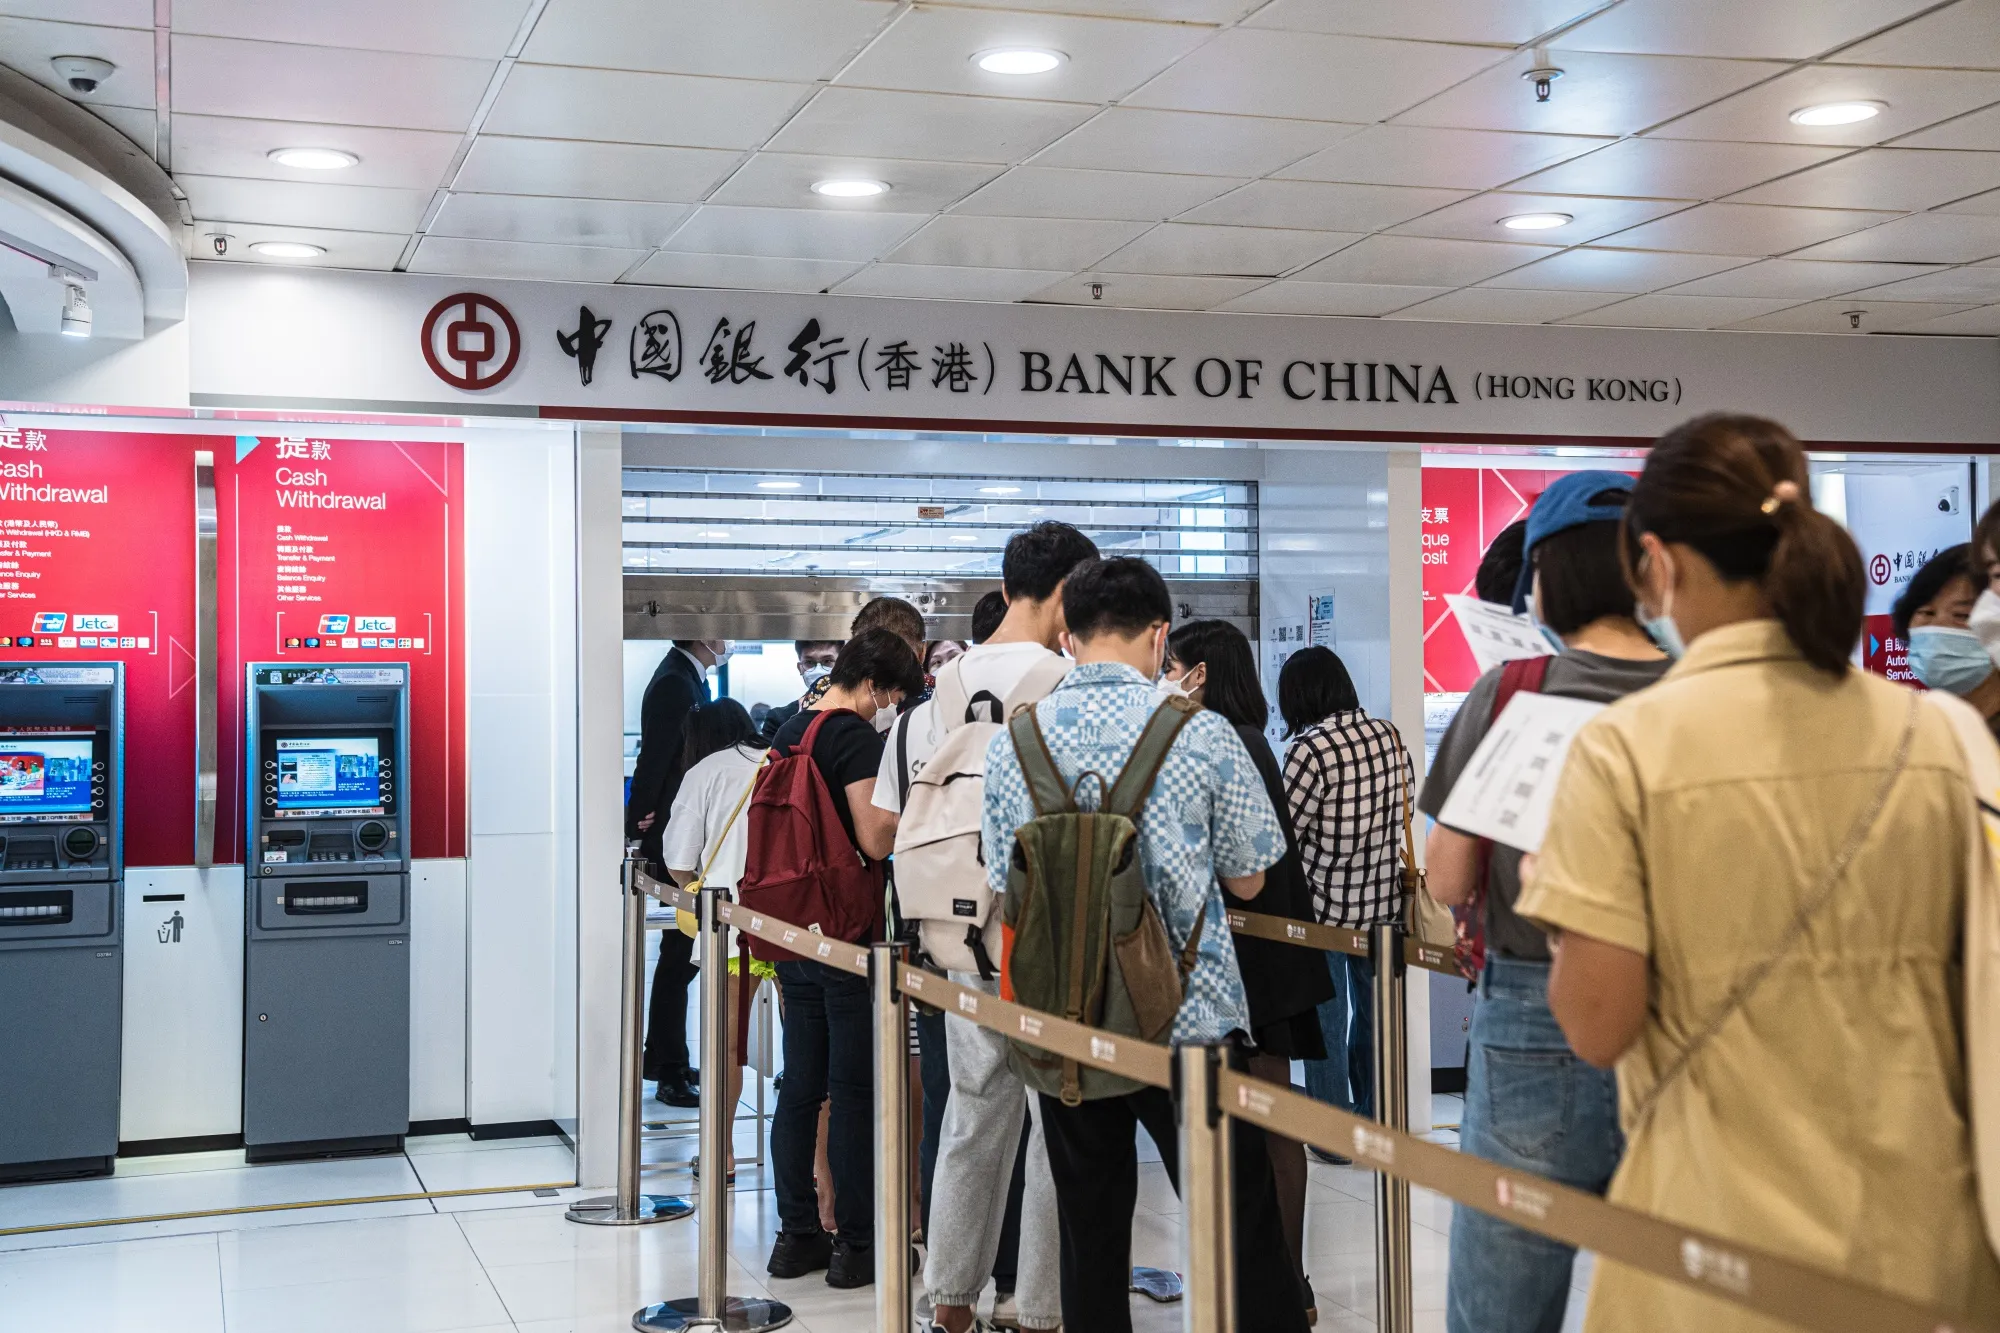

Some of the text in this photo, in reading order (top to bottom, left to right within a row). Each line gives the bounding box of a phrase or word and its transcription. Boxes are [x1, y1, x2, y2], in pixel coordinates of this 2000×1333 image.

[1020, 350, 1177, 397] BANK
[1194, 357, 1263, 399] OF
[1282, 360, 1459, 404] CHINA
[1474, 371, 1576, 401] (HONG
[1588, 375, 1683, 406] KONG)
[275, 437, 331, 460] 提款
[276, 467, 327, 486] Cash
[276, 490, 386, 510] Withdrawal
[294, 534, 329, 542] Withdrawal
[22, 550, 52, 558] Payment
[1885, 637, 1909, 652] 自助
